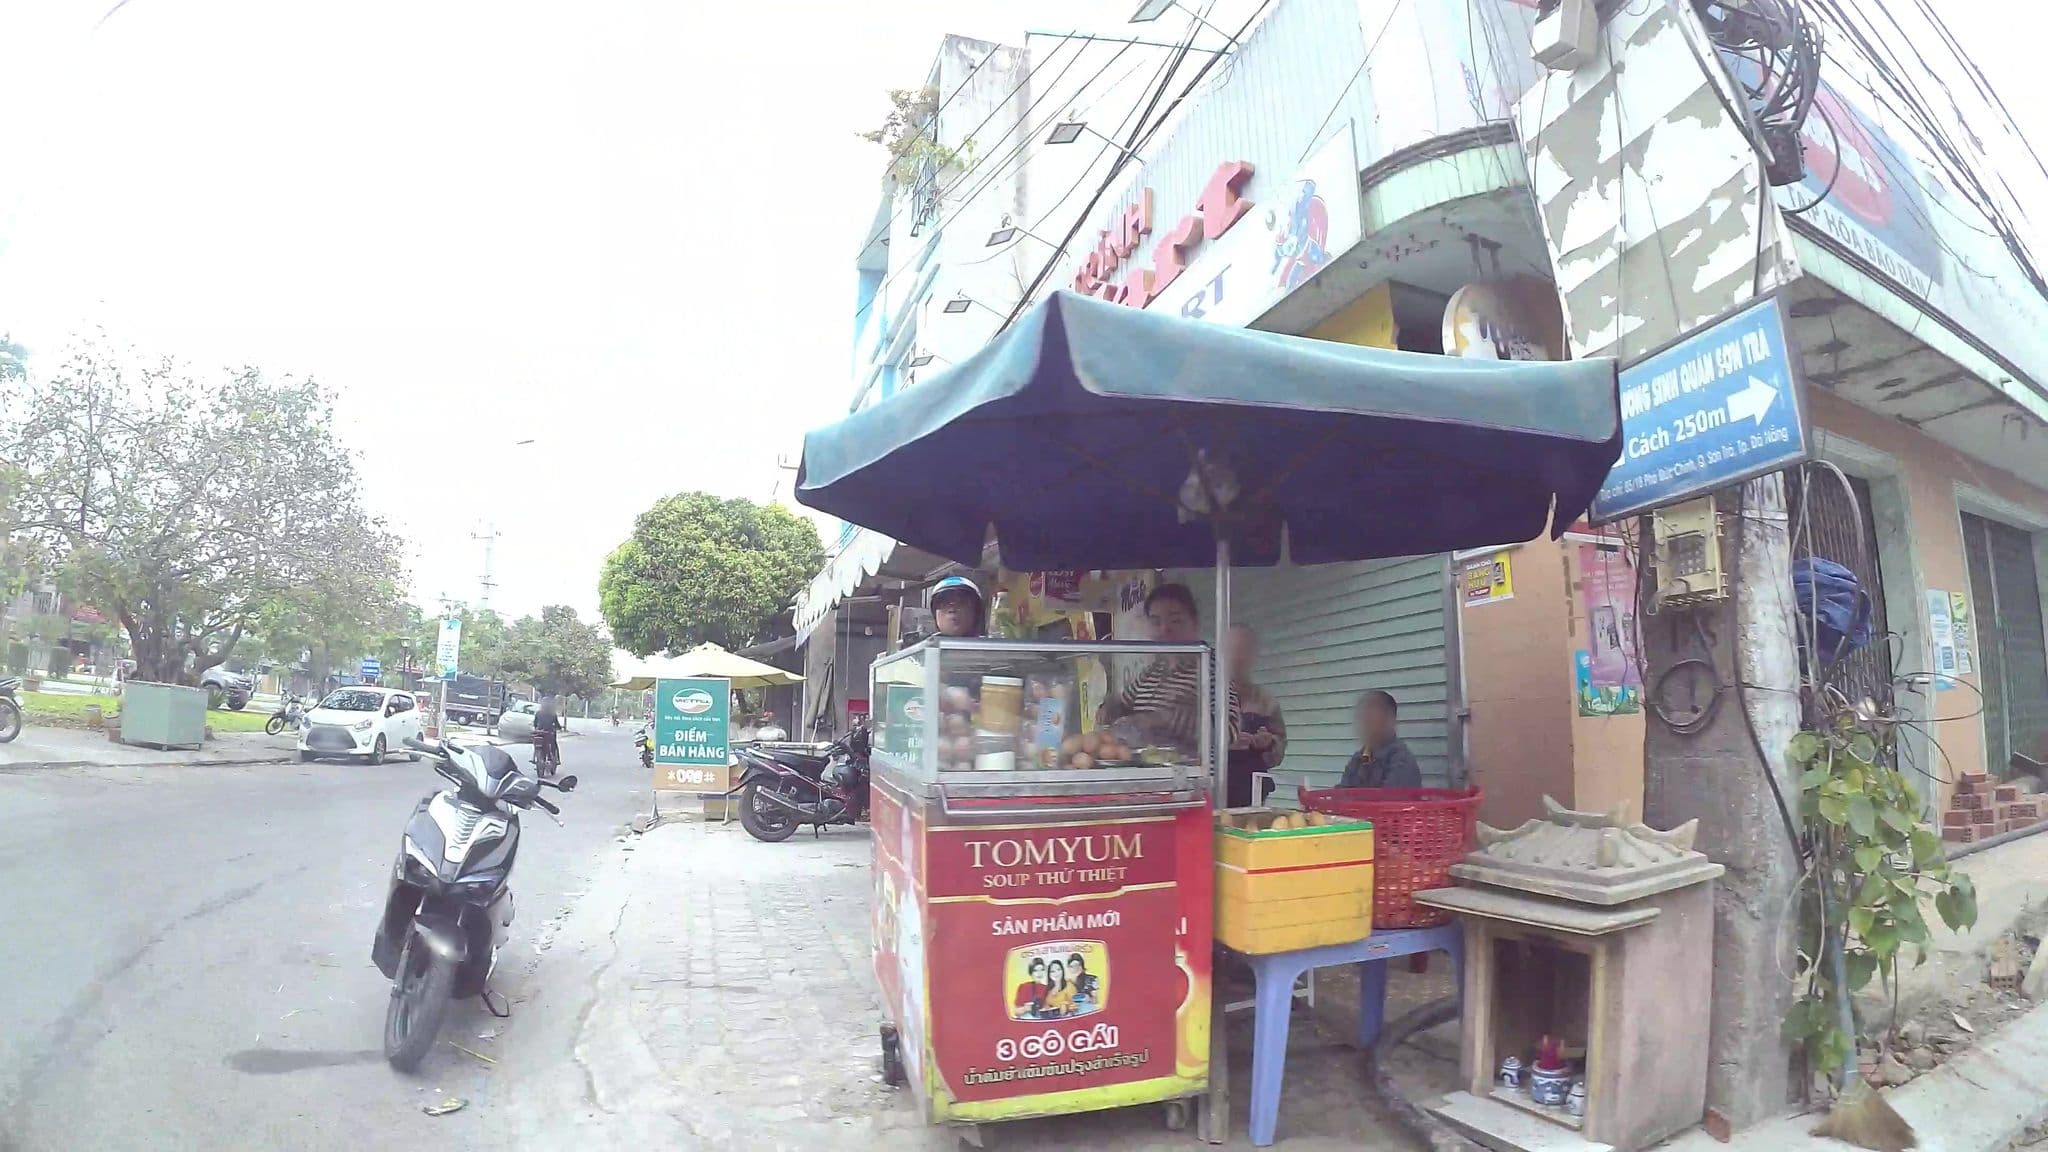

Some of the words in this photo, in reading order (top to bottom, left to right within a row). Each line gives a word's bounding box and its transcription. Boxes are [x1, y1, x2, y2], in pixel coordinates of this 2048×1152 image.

[1627, 426, 1671, 460] Cách
[1673, 405, 1727, 443] 250m
[674, 727, 707, 742] ĐIỂM
[659, 743, 686, 757] BÁN
[688, 744, 725, 759] HÀNG
[964, 833, 1144, 868] TOMYUM
[984, 873, 1030, 888] SOUP
[992, 916, 1029, 936] SẢN
[1031, 911, 1084, 933] PHẨM
[1086, 909, 1121, 929] MỚI
[996, 1038, 1017, 1061] 3
[1020, 1030, 1065, 1058] CÔ
[1067, 1022, 1119, 1052] GÁI
